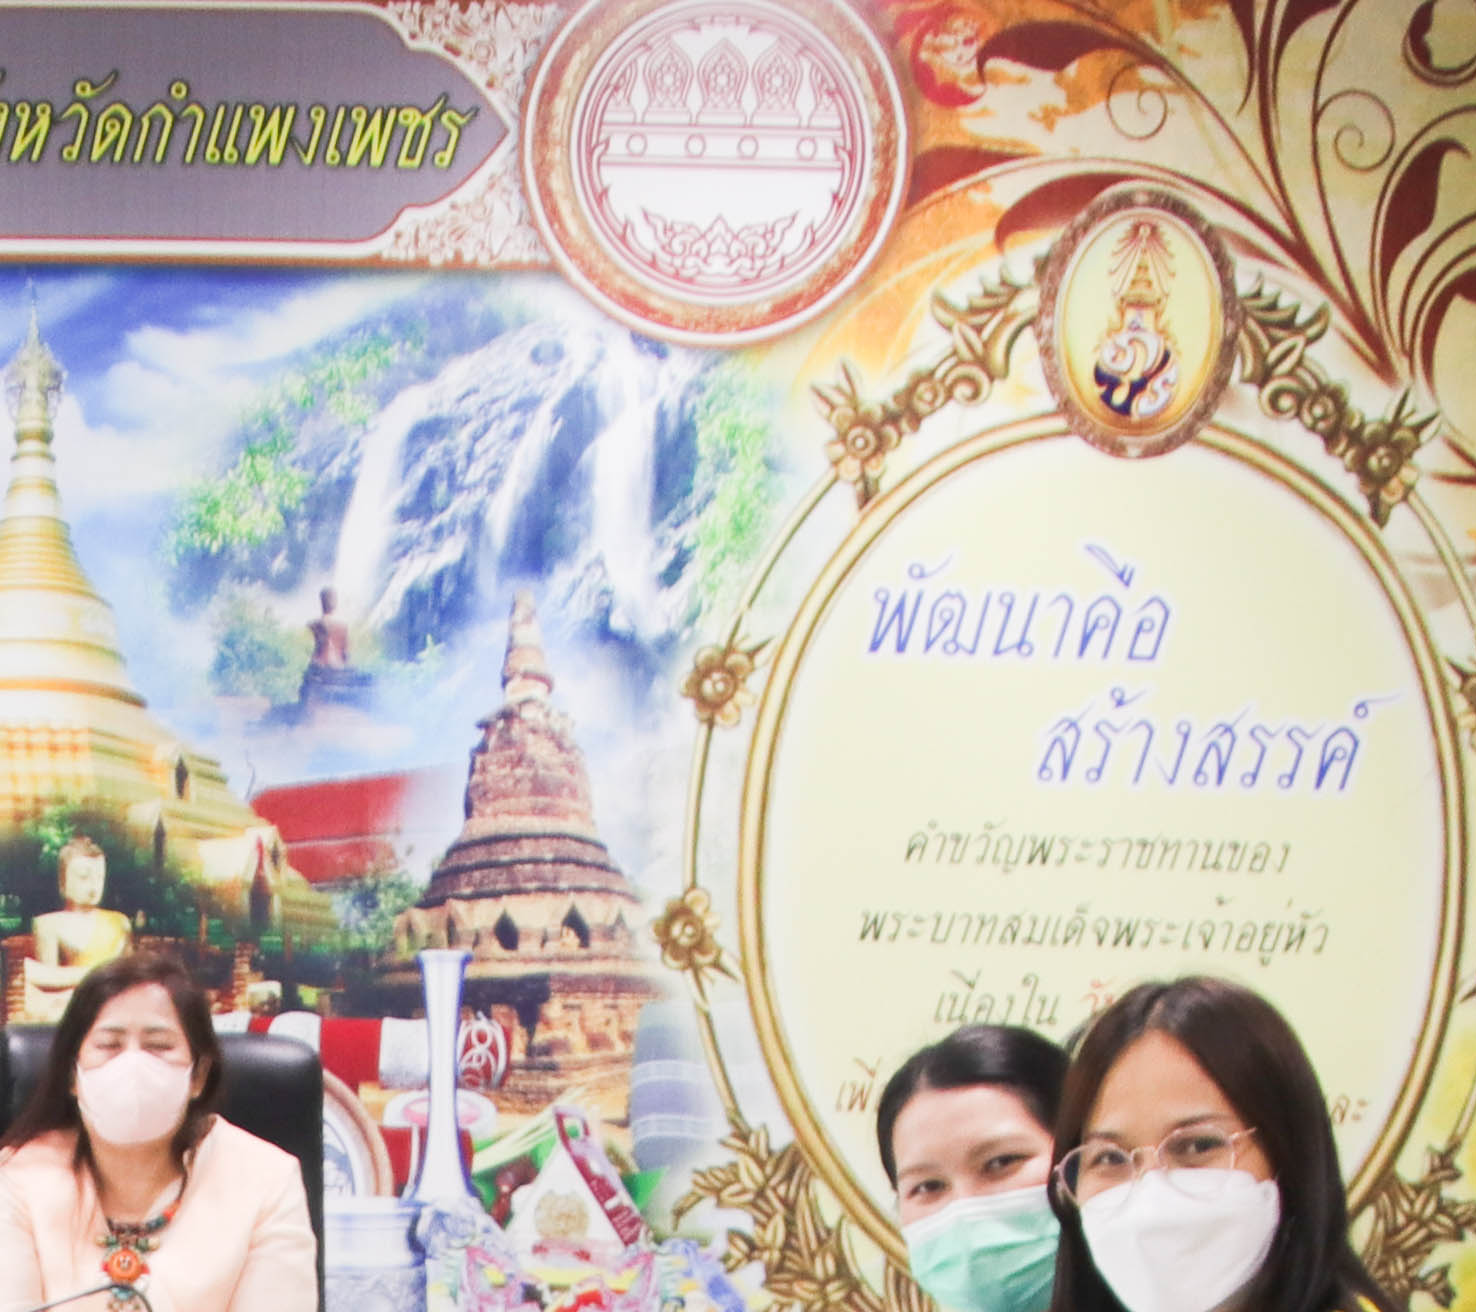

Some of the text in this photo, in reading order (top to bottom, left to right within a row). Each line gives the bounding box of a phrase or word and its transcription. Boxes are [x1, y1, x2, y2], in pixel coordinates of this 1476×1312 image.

[868, 545, 1172, 663] พัฒนาคือ
[1036, 688, 1402, 793] สร้างสรรค์
[903, 819, 1292, 874] คำขวัญพระราชทานของ
[858, 894, 1331, 965] พระบาทสมเด็จพระเจ้าอยู่หัว
